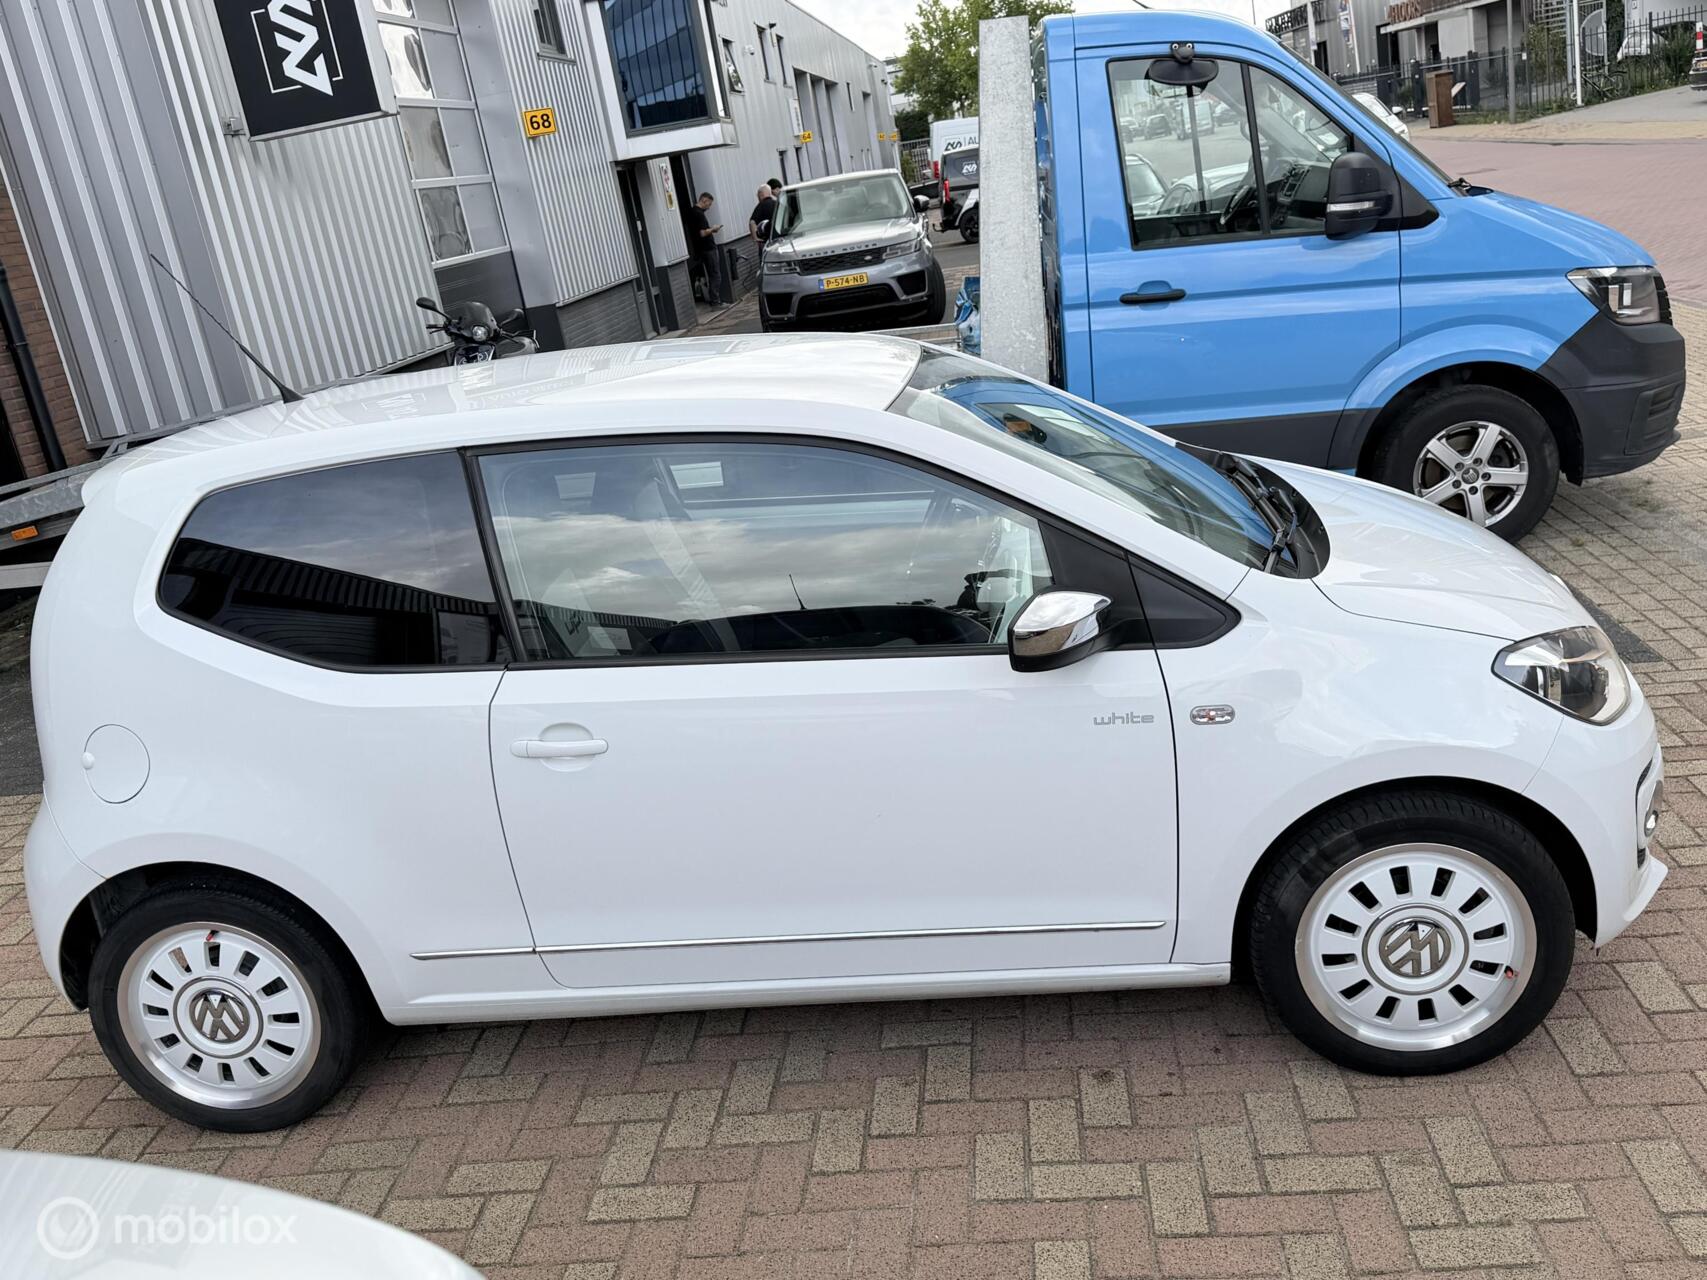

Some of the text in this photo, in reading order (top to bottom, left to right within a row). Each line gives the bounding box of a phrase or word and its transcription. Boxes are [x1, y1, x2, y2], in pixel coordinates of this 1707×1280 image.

[530, 113, 552, 131] 68
[826, 274, 865, 288] P-574-NB
[1093, 711, 1155, 726] white
